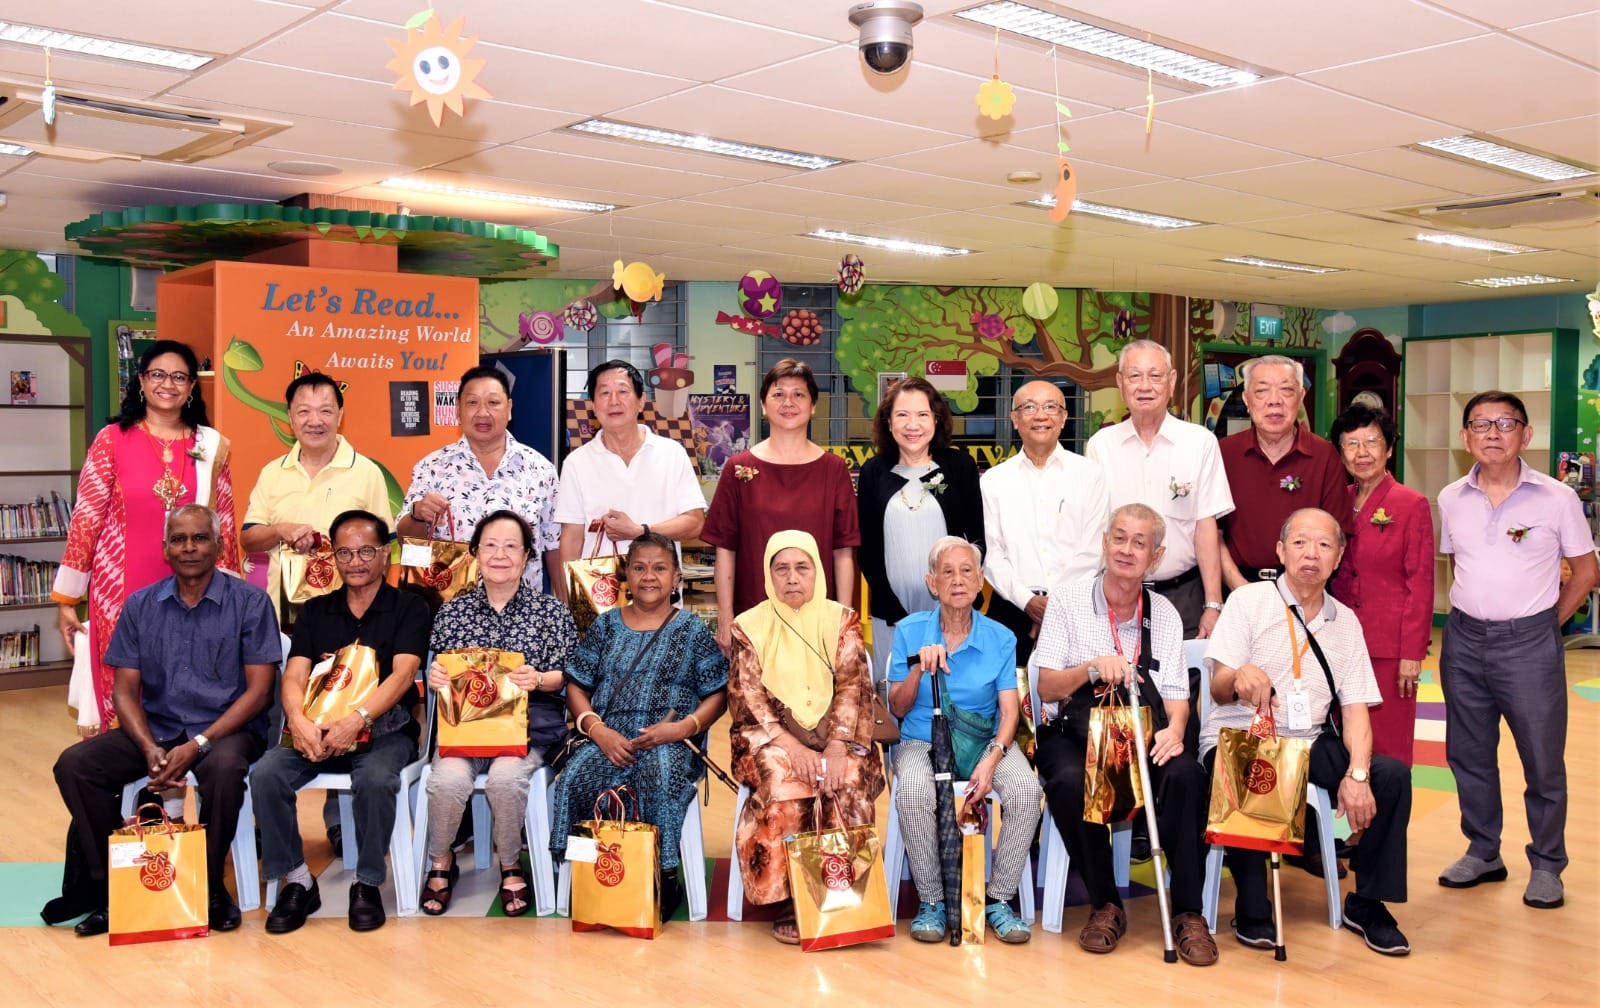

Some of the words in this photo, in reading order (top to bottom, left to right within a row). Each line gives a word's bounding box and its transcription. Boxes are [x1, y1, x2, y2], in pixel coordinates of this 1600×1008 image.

[261, 283, 342, 314] Let's
[351, 288, 460, 319] Read...
[286, 320, 315, 337] An
[320, 322, 410, 344] Amazing
[416, 325, 472, 343] World
[1260, 320, 1277, 335] EXIT
[325, 351, 394, 370] Awaits
[400, 351, 448, 371] You!
[435, 381, 461, 392] SUCC
[691, 394, 737, 406] MYSTERY
[738, 395, 745, 404] &
[695, 404, 749, 414] ADVENTURE
